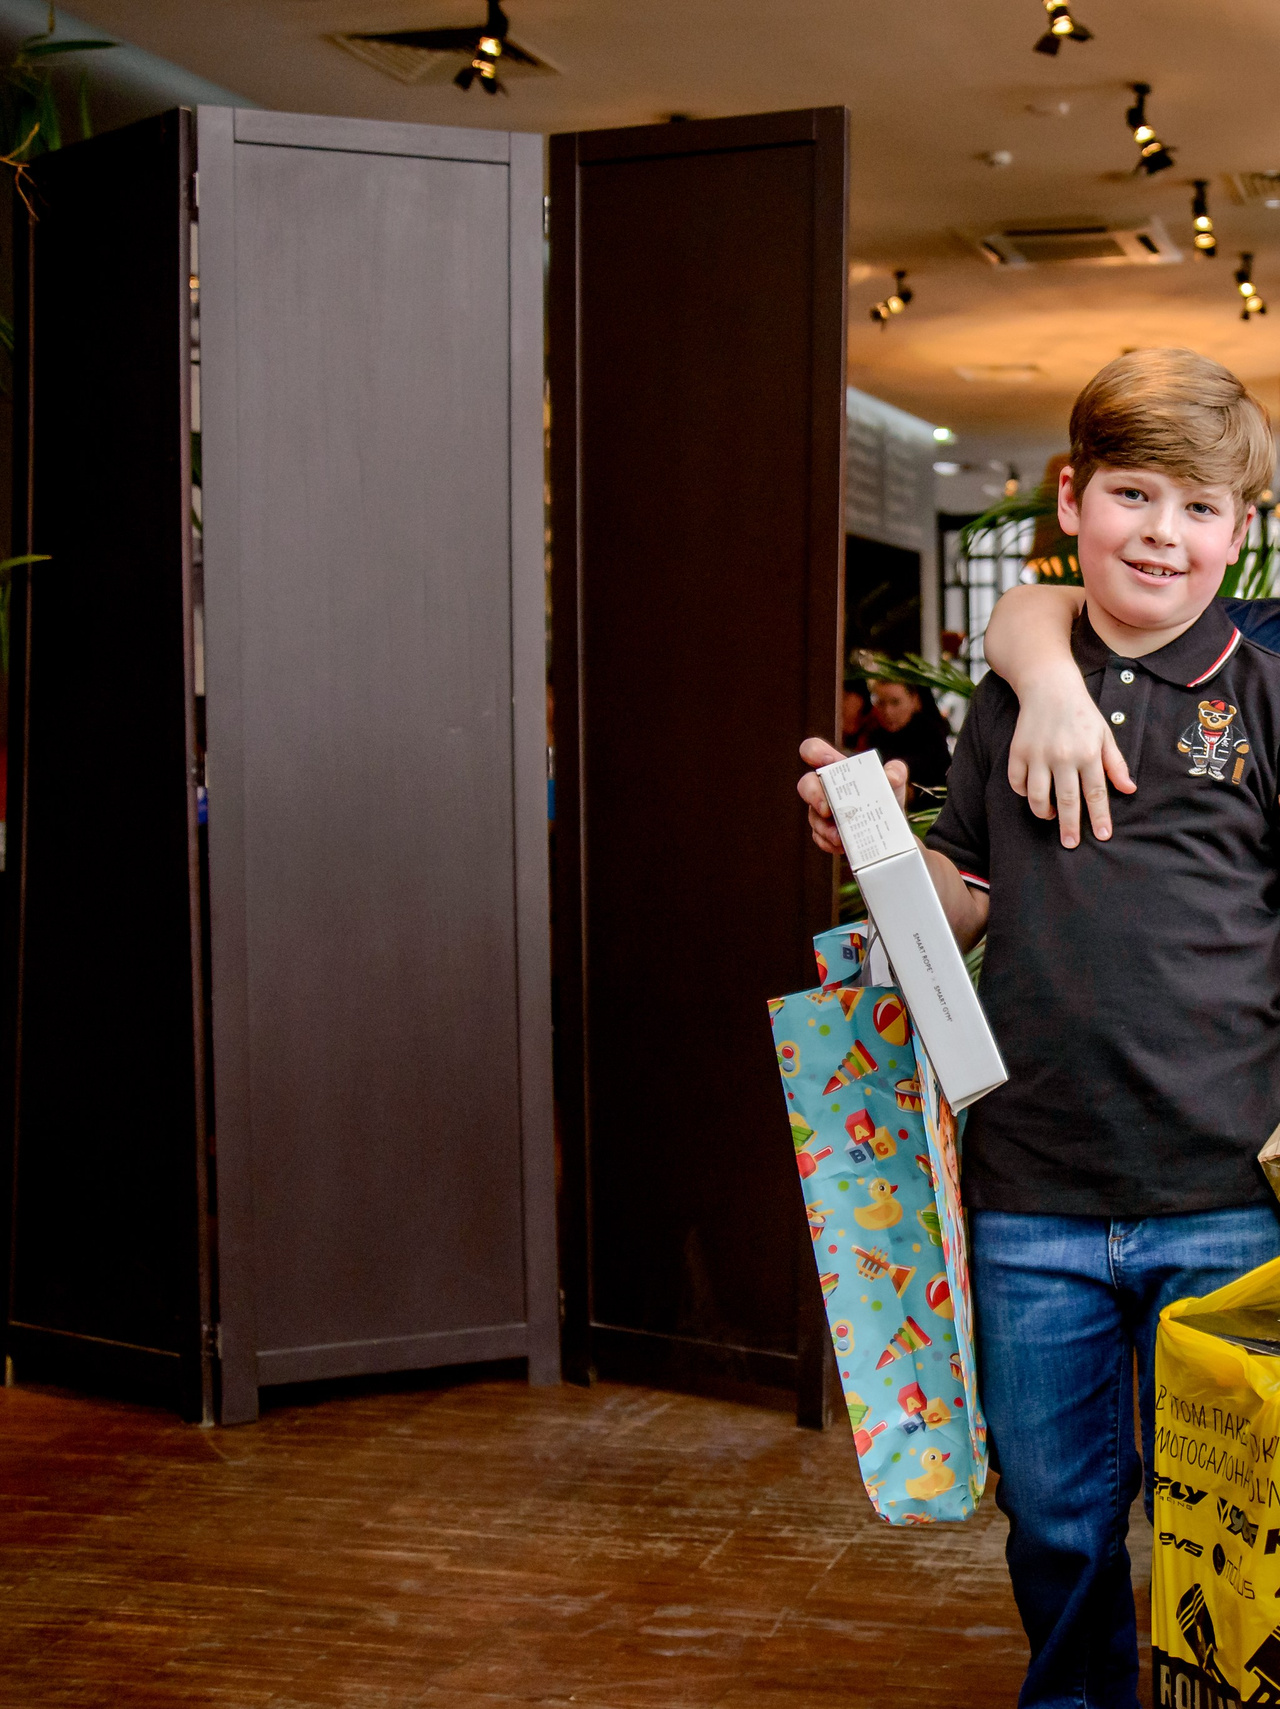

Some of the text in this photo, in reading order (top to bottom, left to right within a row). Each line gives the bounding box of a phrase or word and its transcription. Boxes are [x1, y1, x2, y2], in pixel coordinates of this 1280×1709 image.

[852, 933, 861, 946] A
[842, 946, 854, 960] B
[912, 932, 926, 954] SMART
[933, 985, 947, 1006] SMART
[854, 1124, 870, 1141] A
[849, 1142, 889, 1164] B C
[906, 1396, 922, 1413] A
[903, 1412, 943, 1435] B C
[1154, 1471, 1209, 1505] FLY
